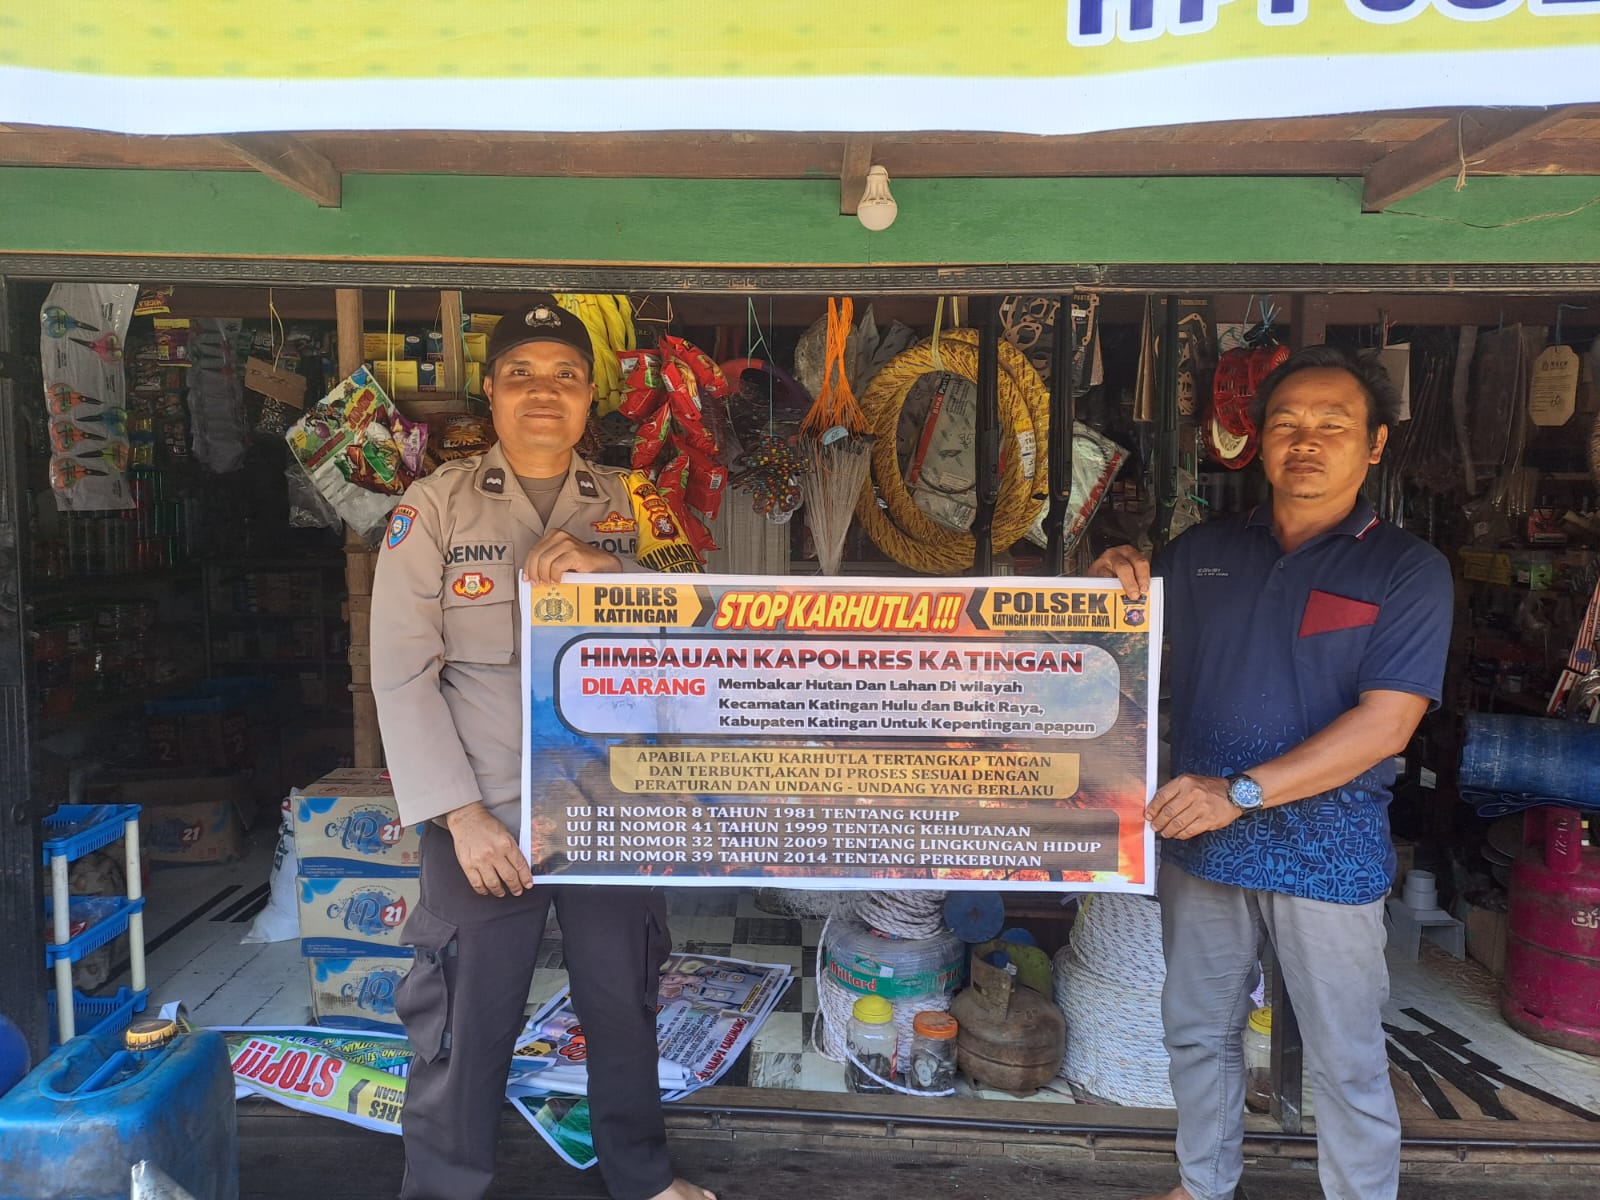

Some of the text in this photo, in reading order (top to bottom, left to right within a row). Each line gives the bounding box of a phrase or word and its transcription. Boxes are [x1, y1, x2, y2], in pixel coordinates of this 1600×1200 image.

[594, 586, 678, 608] POLRES
[992, 591, 1109, 615] POLSEK
[594, 608, 678, 624] KATINGAN
[716, 594, 962, 629] STOP KARHUTLA !!!
[992, 614, 1111, 628] KATINGAN HULU DAN BUKIT RAYA
[580, 646, 1084, 673] HIMBAUAN KAPOLRES KATINGAN
[581, 678, 1024, 696] DILARANG Membakar Hutan Dan Lahan Di wilayah
[718, 699, 1044, 716] Kecamatan Katingan Hulu dan Bukit Raya,
[719, 716, 1096, 735] Kabupaten Katingan Untuk Kepentingan apapun
[637, 751, 1052, 768] APABILA PELAKU KARHUTLA TERTANGKAP TANGAN
[649, 766, 683, 777] DAN
[824, 767, 843, 779] DI
[847, 768, 909, 780] PROSES
[911, 769, 968, 781] SESUAI
[971, 769, 1039, 782] DENGAN
[634, 780, 733, 792] PERATURAN
[737, 780, 770, 792] DAN
[775, 781, 843, 793] UNDANG
[857, 782, 929, 795] UNDANG
[931, 783, 974, 796] YANG
[977, 784, 1054, 797] BERLAKU
[566, 806, 960, 821] UU RI NOMOR 8 TAHUN 1981 TENTANG KUHP
[183, 827, 201, 840] 21
[383, 824, 401, 841] 21
[566, 821, 1032, 837] UU RI NOMOR 41 TAHUN 1999 TENTANG KEHUTANAN
[566, 836, 1102, 853] UU RI NOMOR 32 TAHUN 2009 TENTANG LINGKUNGAN HIDUP
[566, 851, 1042, 867] UU RI NOMOR 39 TAHUN 2014 TENTANG PERKEBUNAN
[384, 906, 402, 922] 21
[830, 959, 877, 991] Milliard
[232, 1040, 343, 1098] STOP!!!
